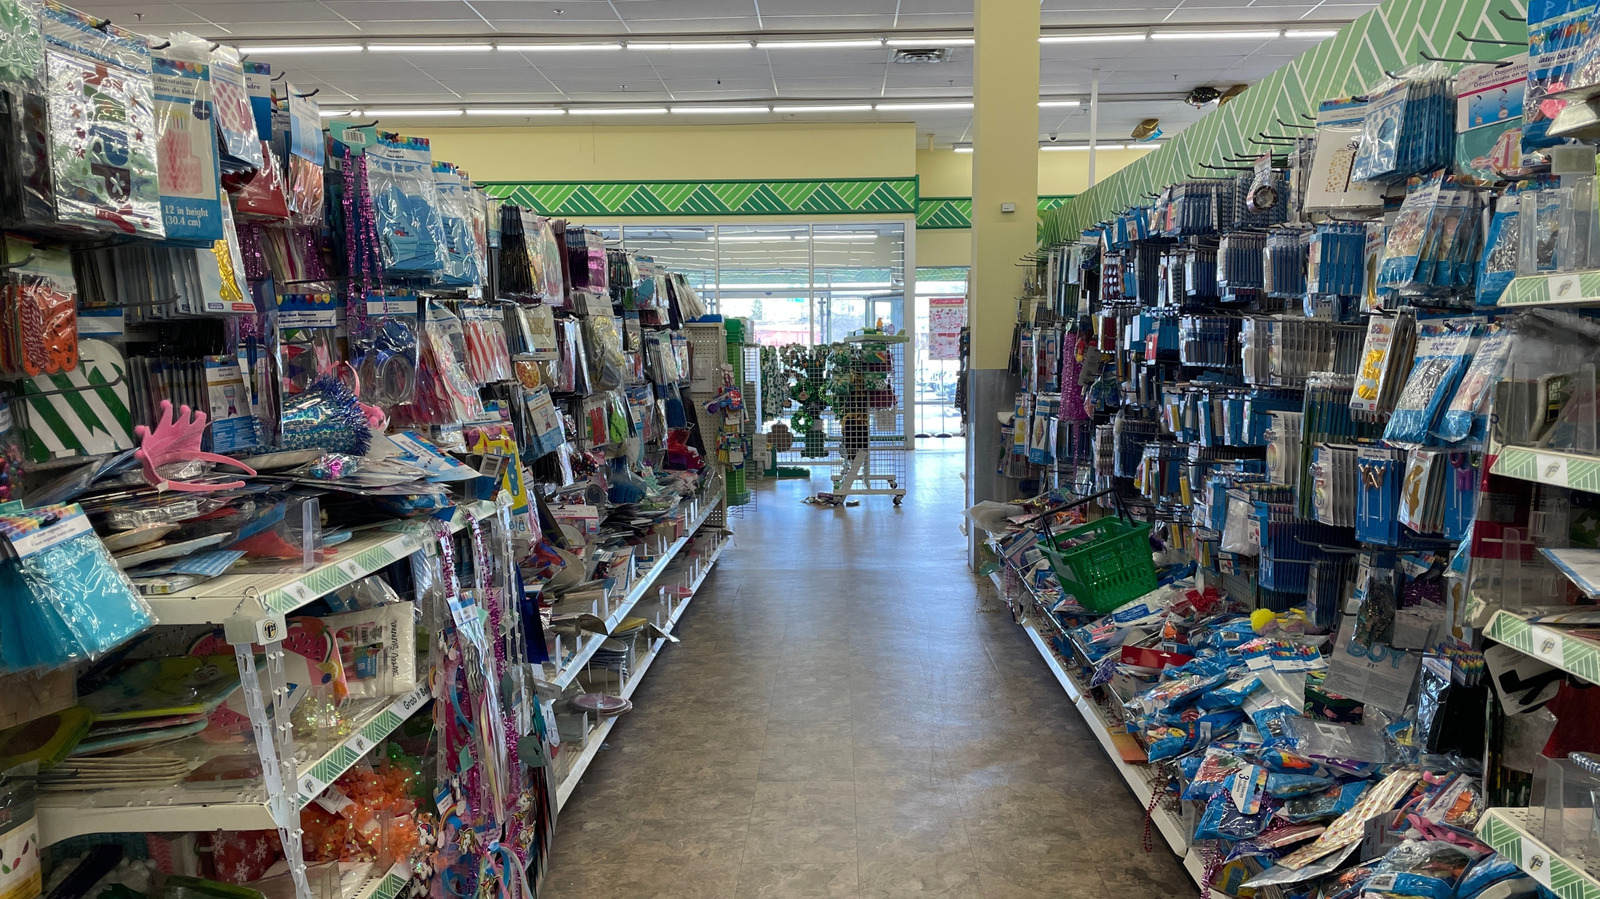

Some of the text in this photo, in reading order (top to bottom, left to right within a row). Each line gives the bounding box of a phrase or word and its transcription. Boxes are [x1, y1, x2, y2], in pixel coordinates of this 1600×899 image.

[1478, 64, 1528, 81] Swirl Decoration
[157, 76, 193, 87] decoration
[165, 205, 208, 218] 12 in height
[165, 215, 201, 228] (30.4 cm)
[509, 520, 526, 532] BIG
[403, 695, 417, 710] Grab
